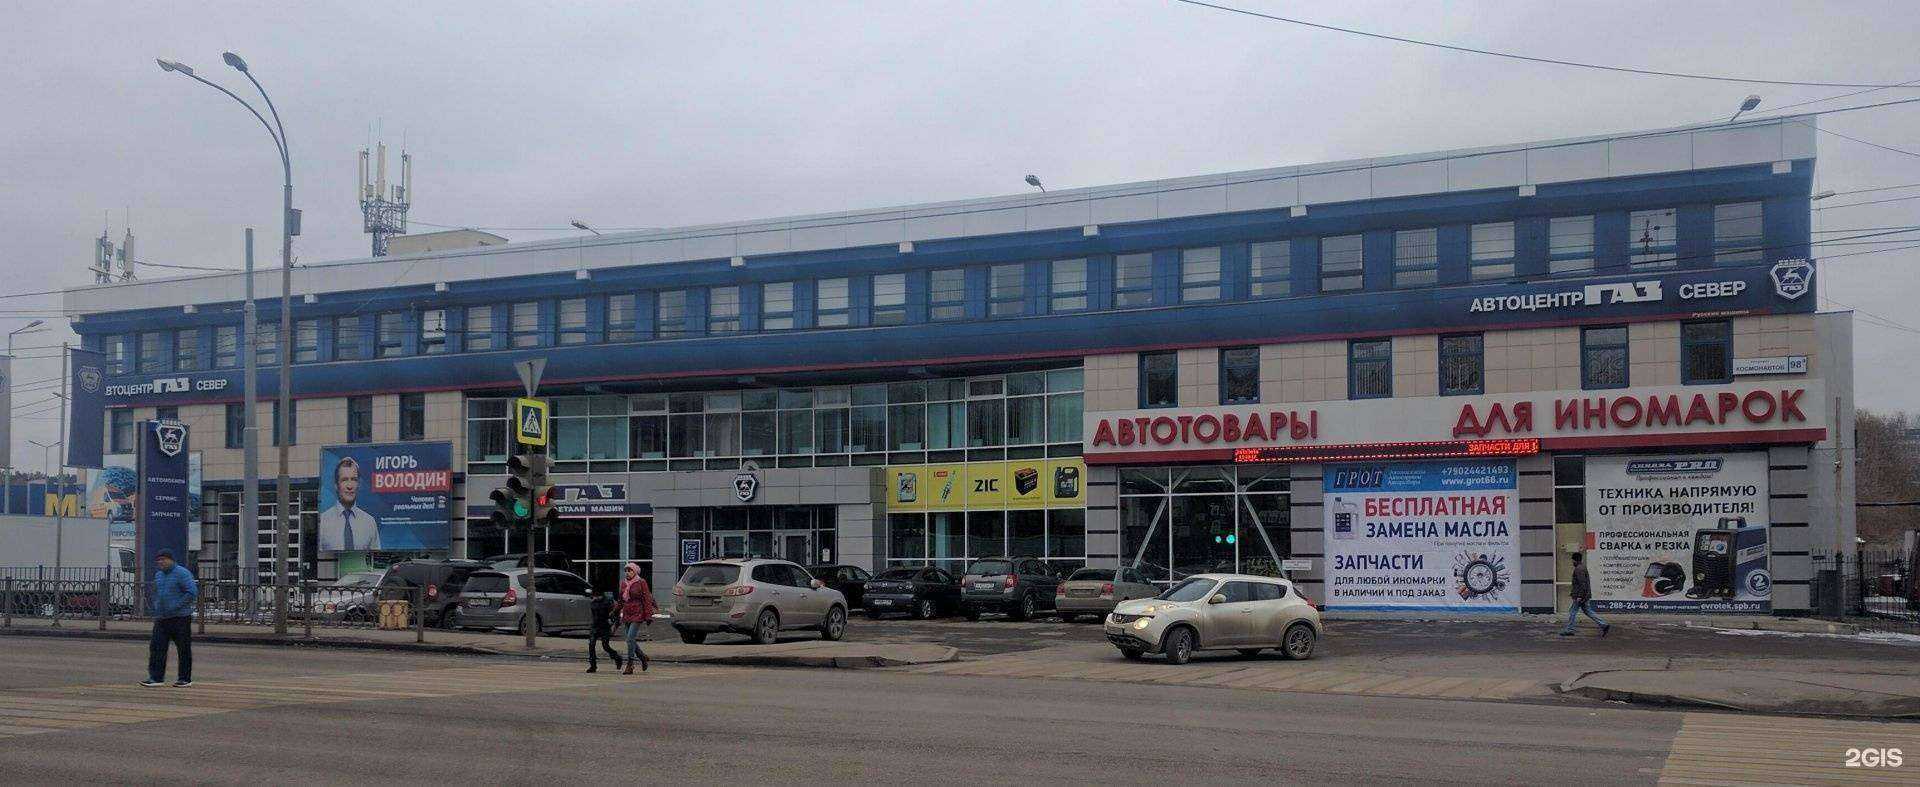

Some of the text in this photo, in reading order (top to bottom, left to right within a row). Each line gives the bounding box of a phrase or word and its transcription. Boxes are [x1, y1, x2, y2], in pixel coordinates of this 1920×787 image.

[1470, 280, 1746, 313] АВТОЦЕНТР ГАЗ СЕВЕР
[105, 383, 153, 396] ВТОЦЕНТР
[196, 379, 227, 390] СЕВЕР
[1453, 389, 1806, 439] ДЛЯ ИНОМАРОК
[1093, 410, 1318, 446] АВТОТОВАРЫ
[1468, 443, 1510, 452] ЗАПЧАСТИ
[375, 455, 418, 470] ИГОРЬ
[375, 472, 447, 490] ВОЛОДИН
[974, 479, 1000, 492] ZIC
[1335, 470, 1382, 486] ГРОТ
[1598, 485, 1757, 499] ТЕХНИКА НАПРЯМУЮ
[555, 504, 624, 513] ЕТАЛИ МАШИН
[1365, 495, 1506, 517] БЕСПЛАТНАЯ
[1598, 502, 1754, 516] ОТ ПРОИЗВОДИТЕЛЯ!
[1366, 521, 1509, 538] ЗАМЕНА МАСЛА
[1599, 542, 1641, 550] СВАРКА
[1655, 541, 1690, 550] РЕЗКА
[1334, 554, 1424, 570] ЗАПЧАСТИ
[1334, 575, 1446, 586] ДЛЯ ЛЮБОЙ ИНОМАРКИ
[1334, 589, 1446, 598] В НАЛИЧИИ И ПОД ЗАКАЗ
[1701, 603, 1760, 611] evrotek.spb.ru
